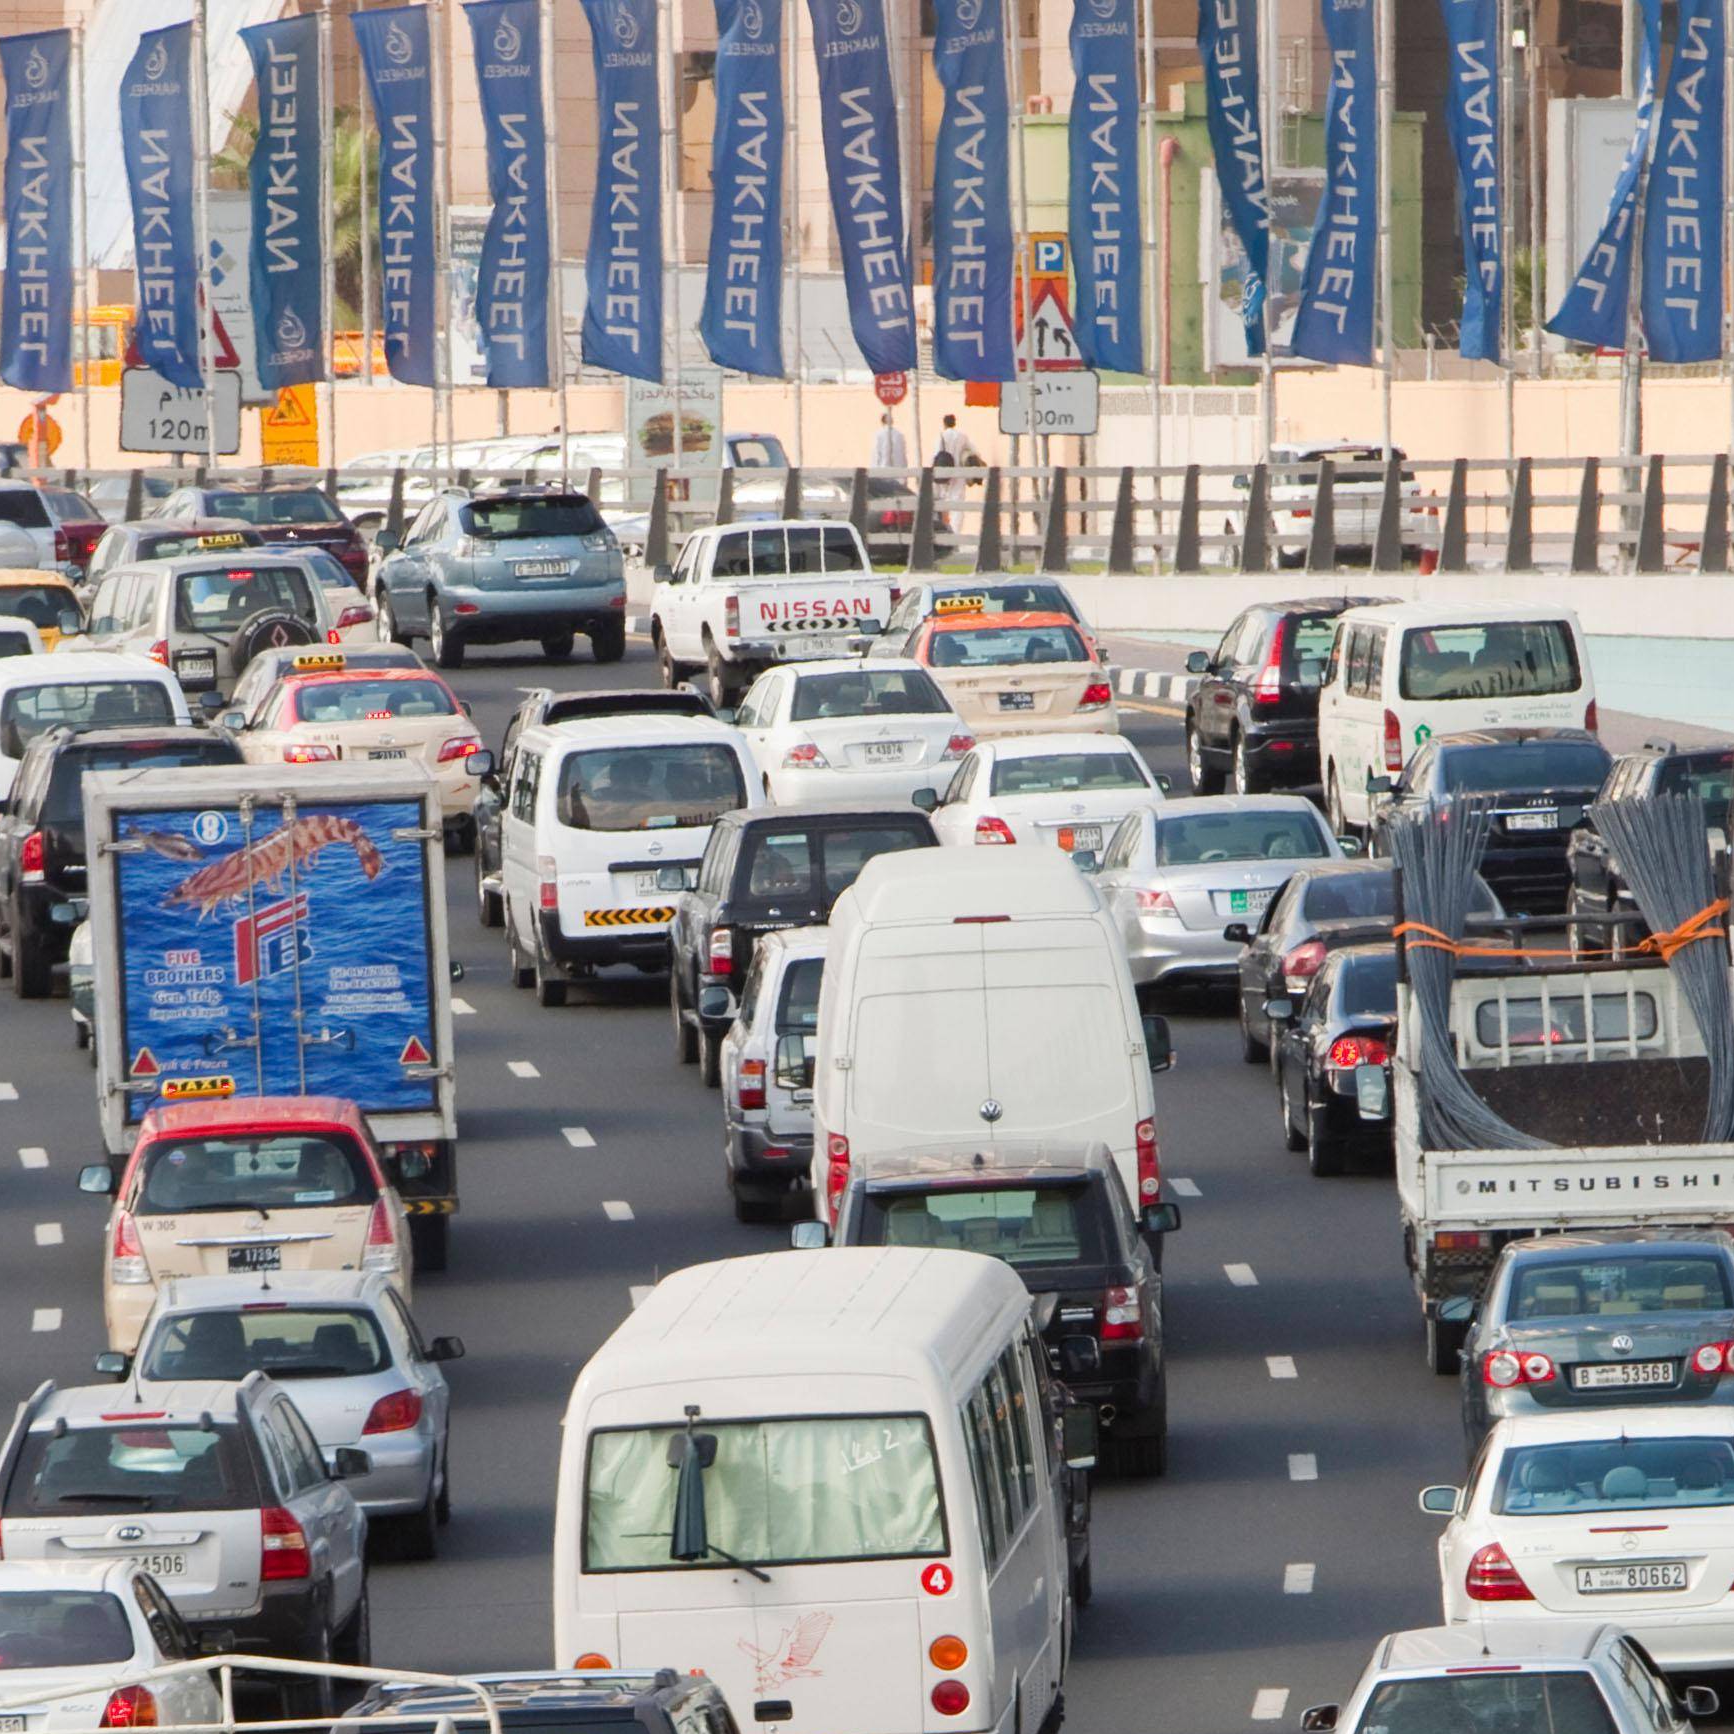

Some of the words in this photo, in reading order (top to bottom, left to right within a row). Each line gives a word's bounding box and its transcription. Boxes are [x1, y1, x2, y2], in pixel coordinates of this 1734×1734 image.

[1038, 242, 1062, 271] P
[760, 598, 872, 621] NISSAN
[202, 816, 214, 840] 8
[167, 951, 199, 965] FIVE
[147, 968, 223, 984] BROTHERS
[1478, 1172, 1721, 1193] MITSUBISHI
[143, 1221, 154, 1231] W
[157, 1220, 177, 1231] 305
[1580, 1369, 1589, 1384] B
[1622, 1363, 1671, 1384] 53568
[930, 1568, 947, 1591] 4
[1584, 1571, 1593, 1587] A
[1628, 1566, 1683, 1587] 80662
